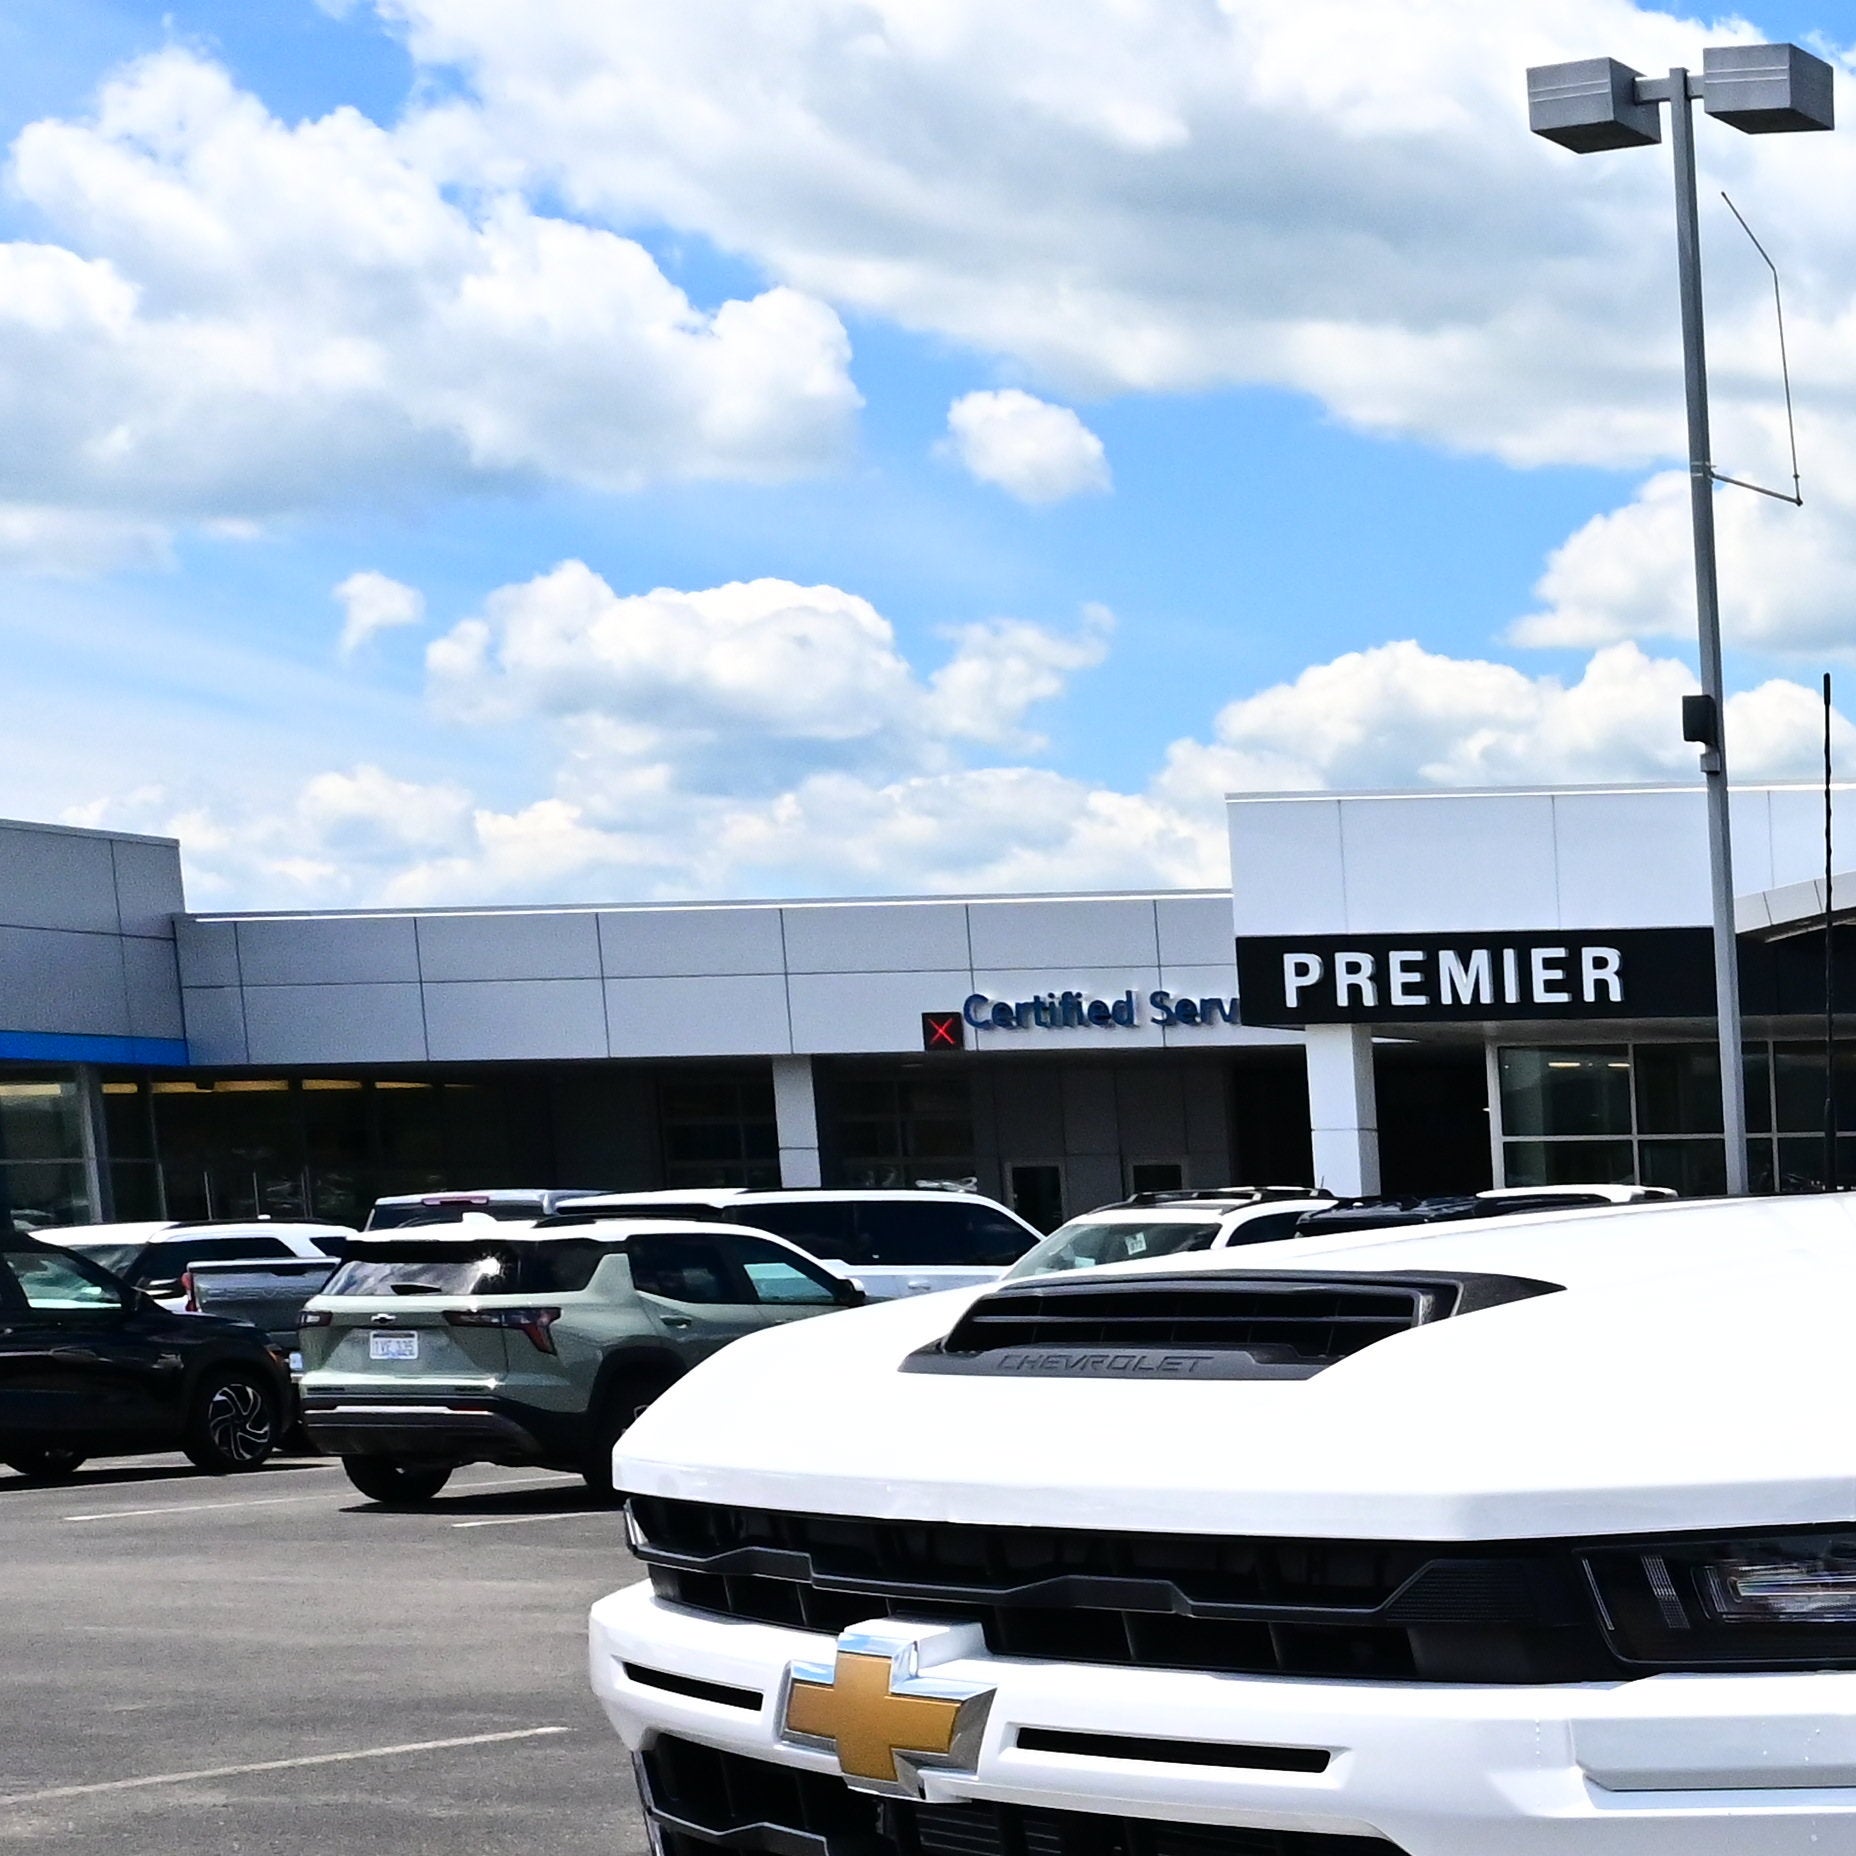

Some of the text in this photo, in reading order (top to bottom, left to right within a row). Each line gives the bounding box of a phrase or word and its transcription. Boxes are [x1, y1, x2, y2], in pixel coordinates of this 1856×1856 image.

[1283, 946, 1624, 1008] PREMIER
[963, 989, 1138, 1029] Certified
[997, 1353, 1216, 1374] CHEVROLET
